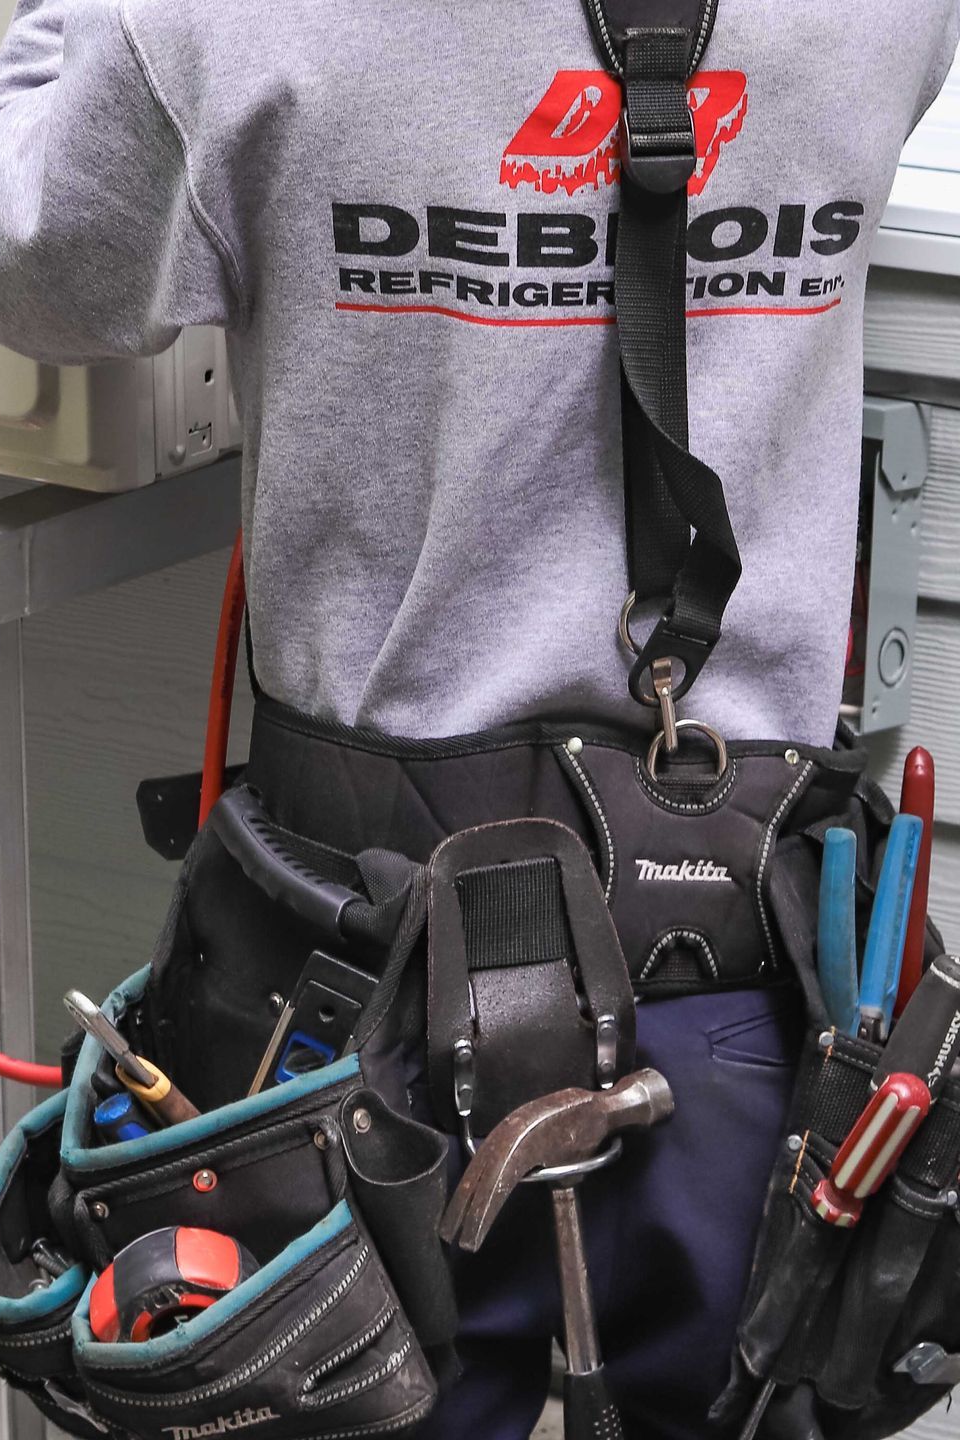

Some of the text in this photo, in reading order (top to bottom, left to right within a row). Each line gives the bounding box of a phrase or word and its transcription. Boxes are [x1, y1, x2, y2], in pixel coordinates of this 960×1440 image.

[340, 267, 786, 307] REFRIGERION
[635, 858, 732, 881] Makita
[161, 1406, 281, 1440] Makita
